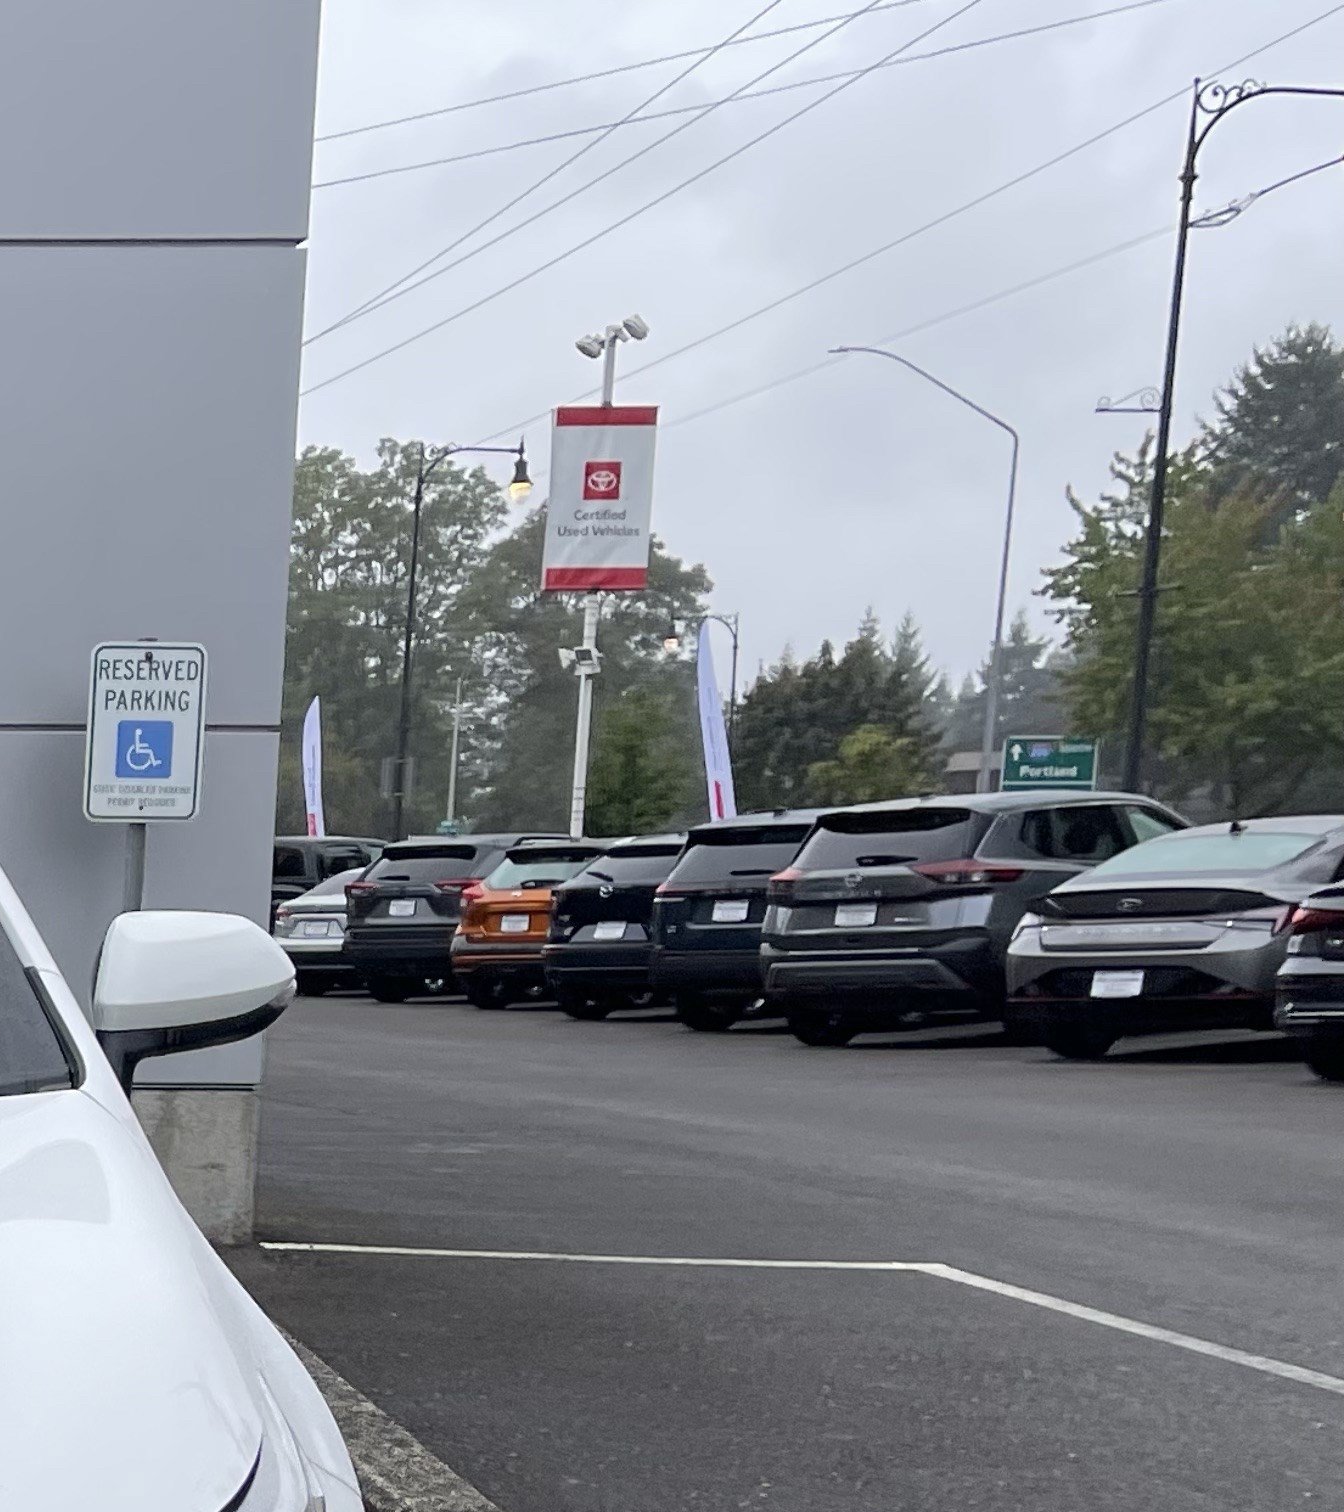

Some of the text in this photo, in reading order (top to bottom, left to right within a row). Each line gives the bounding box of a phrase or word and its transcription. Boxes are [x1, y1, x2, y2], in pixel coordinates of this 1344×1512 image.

[574, 509, 627, 521] Certified
[558, 526, 640, 537] Used Vehicles
[98, 658, 199, 681] RESERVED
[104, 690, 191, 712] PARKING
[1019, 765, 1078, 778] Portland
